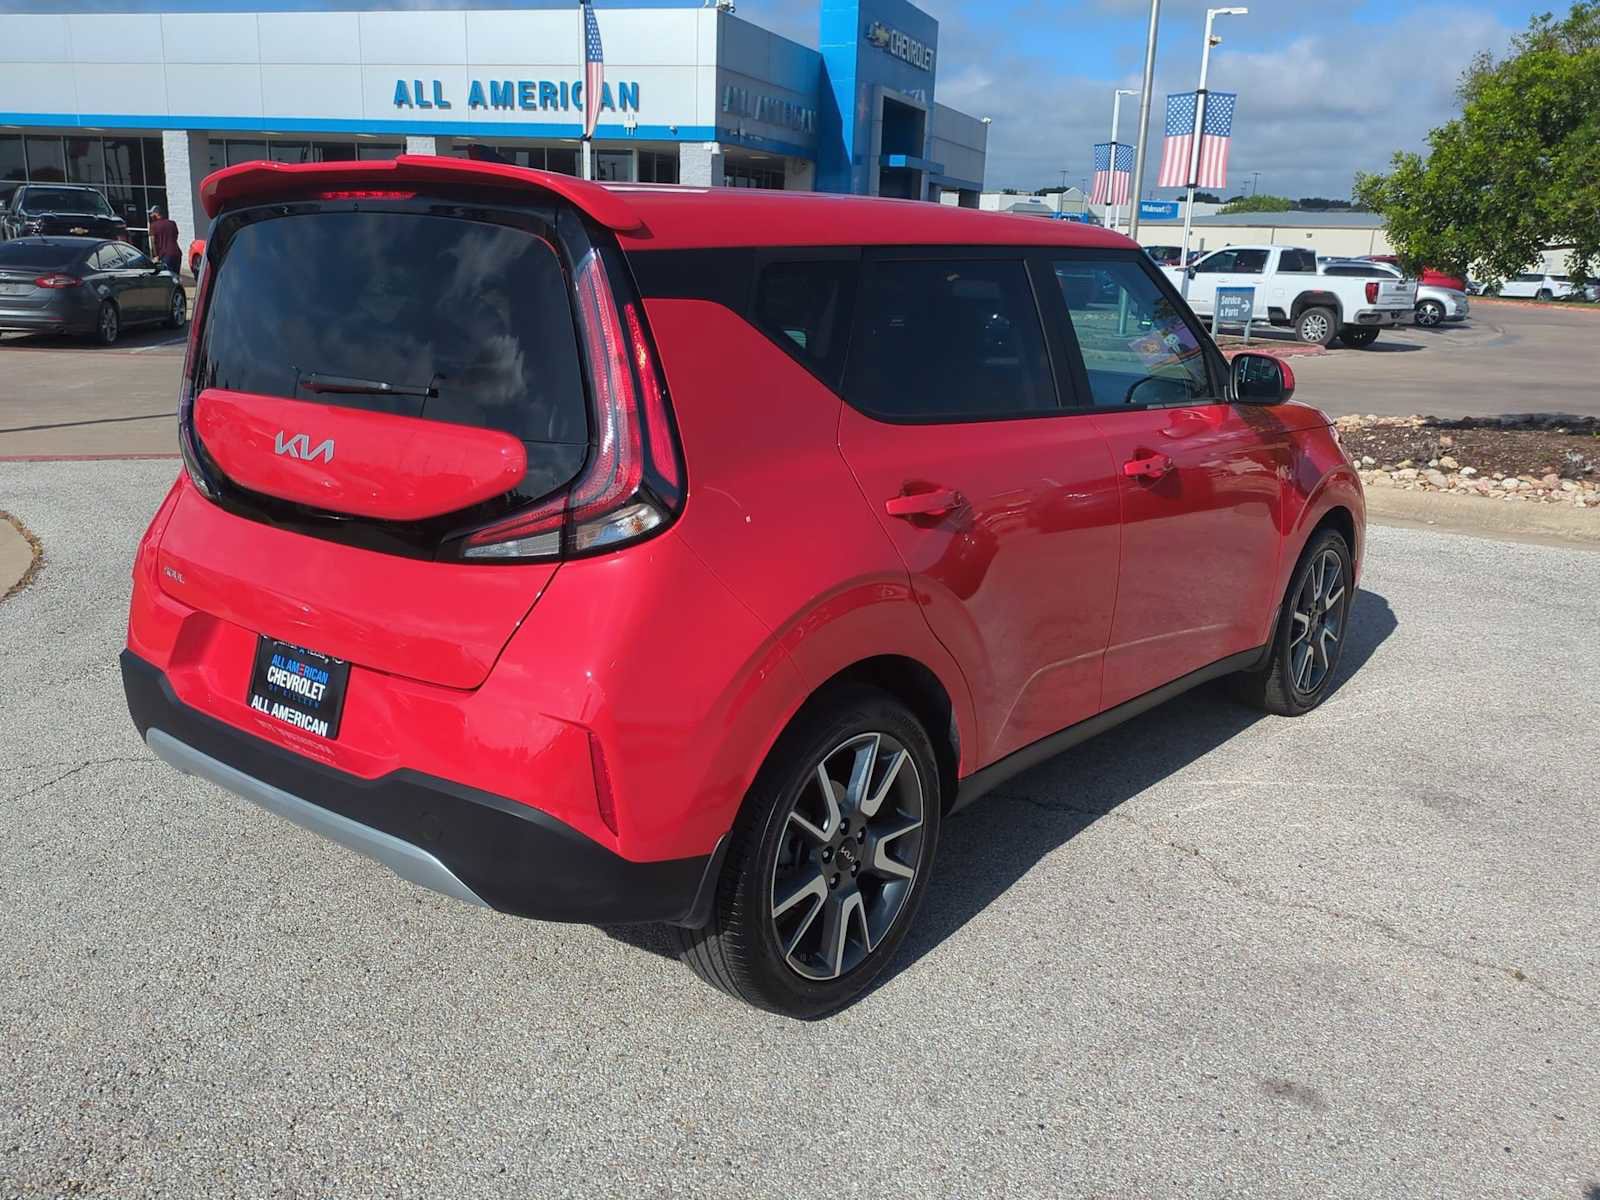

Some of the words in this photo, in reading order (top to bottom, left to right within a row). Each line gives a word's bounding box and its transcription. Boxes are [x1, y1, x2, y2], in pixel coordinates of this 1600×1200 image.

[890, 28, 935, 73] CHEVROLET
[393, 79, 452, 109] ALL
[468, 79, 640, 112] AMERICAN
[274, 430, 335, 464] KIA
[267, 665, 326, 702] CHEVROLET
[271, 654, 285, 669] ALL
[286, 660, 328, 684] AMERICAN
[251, 695, 269, 714] ALL
[270, 702, 328, 737] AMERICAN
